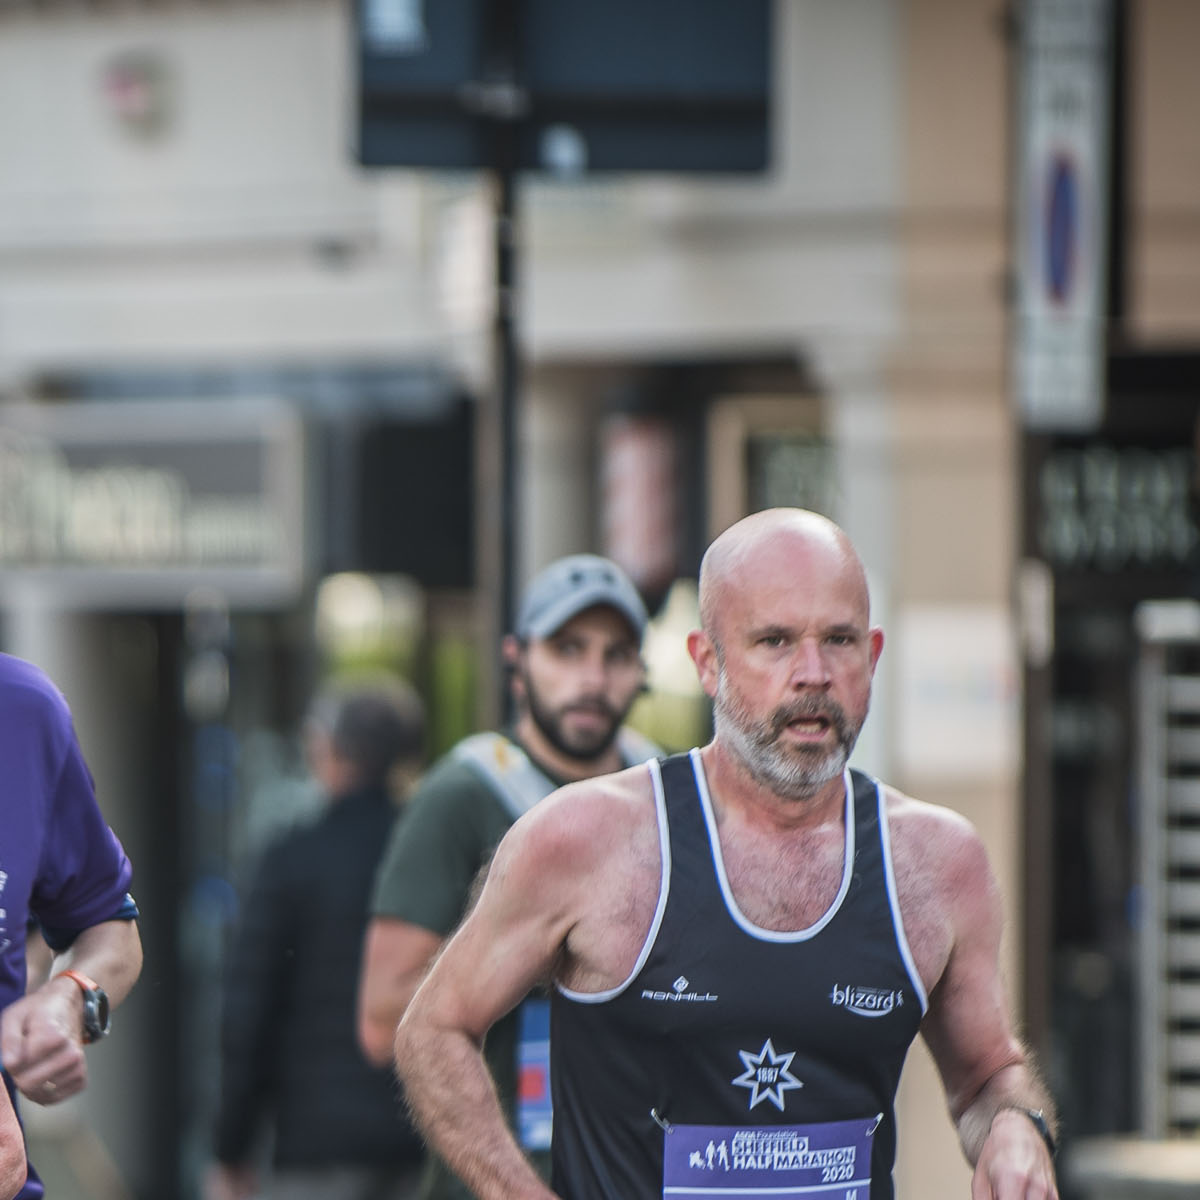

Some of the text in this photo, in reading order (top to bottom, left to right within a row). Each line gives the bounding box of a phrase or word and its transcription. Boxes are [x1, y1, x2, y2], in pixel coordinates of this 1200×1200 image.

[733, 1139, 807, 1155] SHEFFIELD
[733, 1147, 855, 1169] HALF MARATHON
[822, 1165, 855, 1183] 2020
